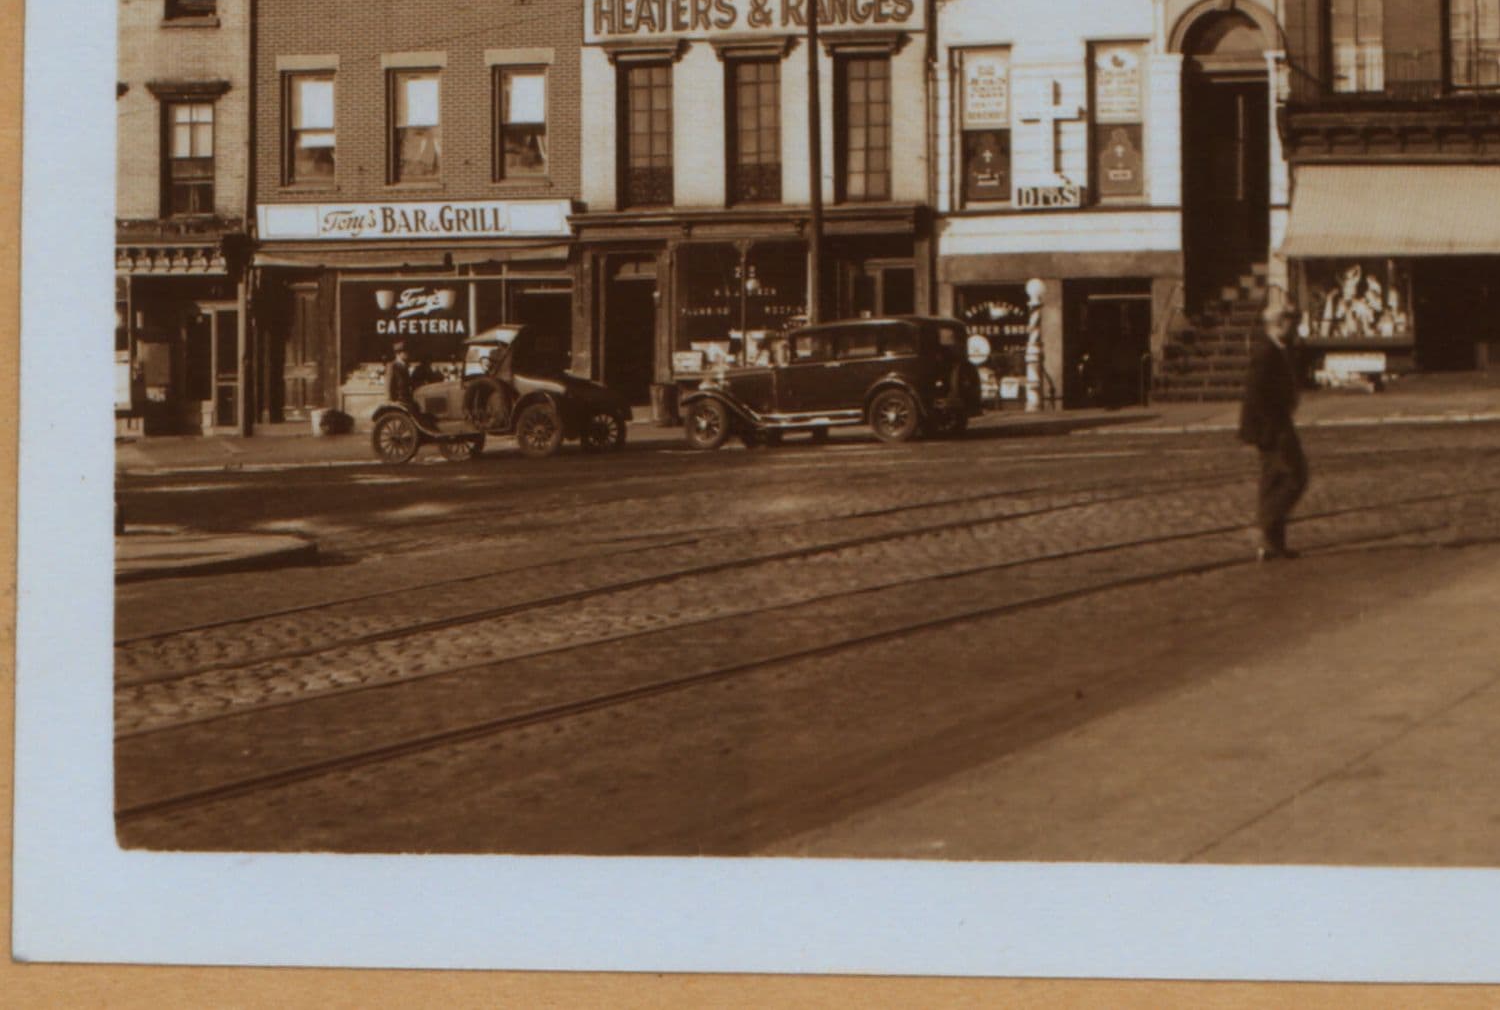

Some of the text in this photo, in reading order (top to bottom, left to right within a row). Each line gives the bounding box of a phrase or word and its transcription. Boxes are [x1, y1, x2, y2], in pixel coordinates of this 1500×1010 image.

[321, 208, 378, 239] Tony's
[381, 206, 429, 234] BAR
[439, 204, 506, 233] GRILL
[376, 317, 466, 335] CAFETERIA
